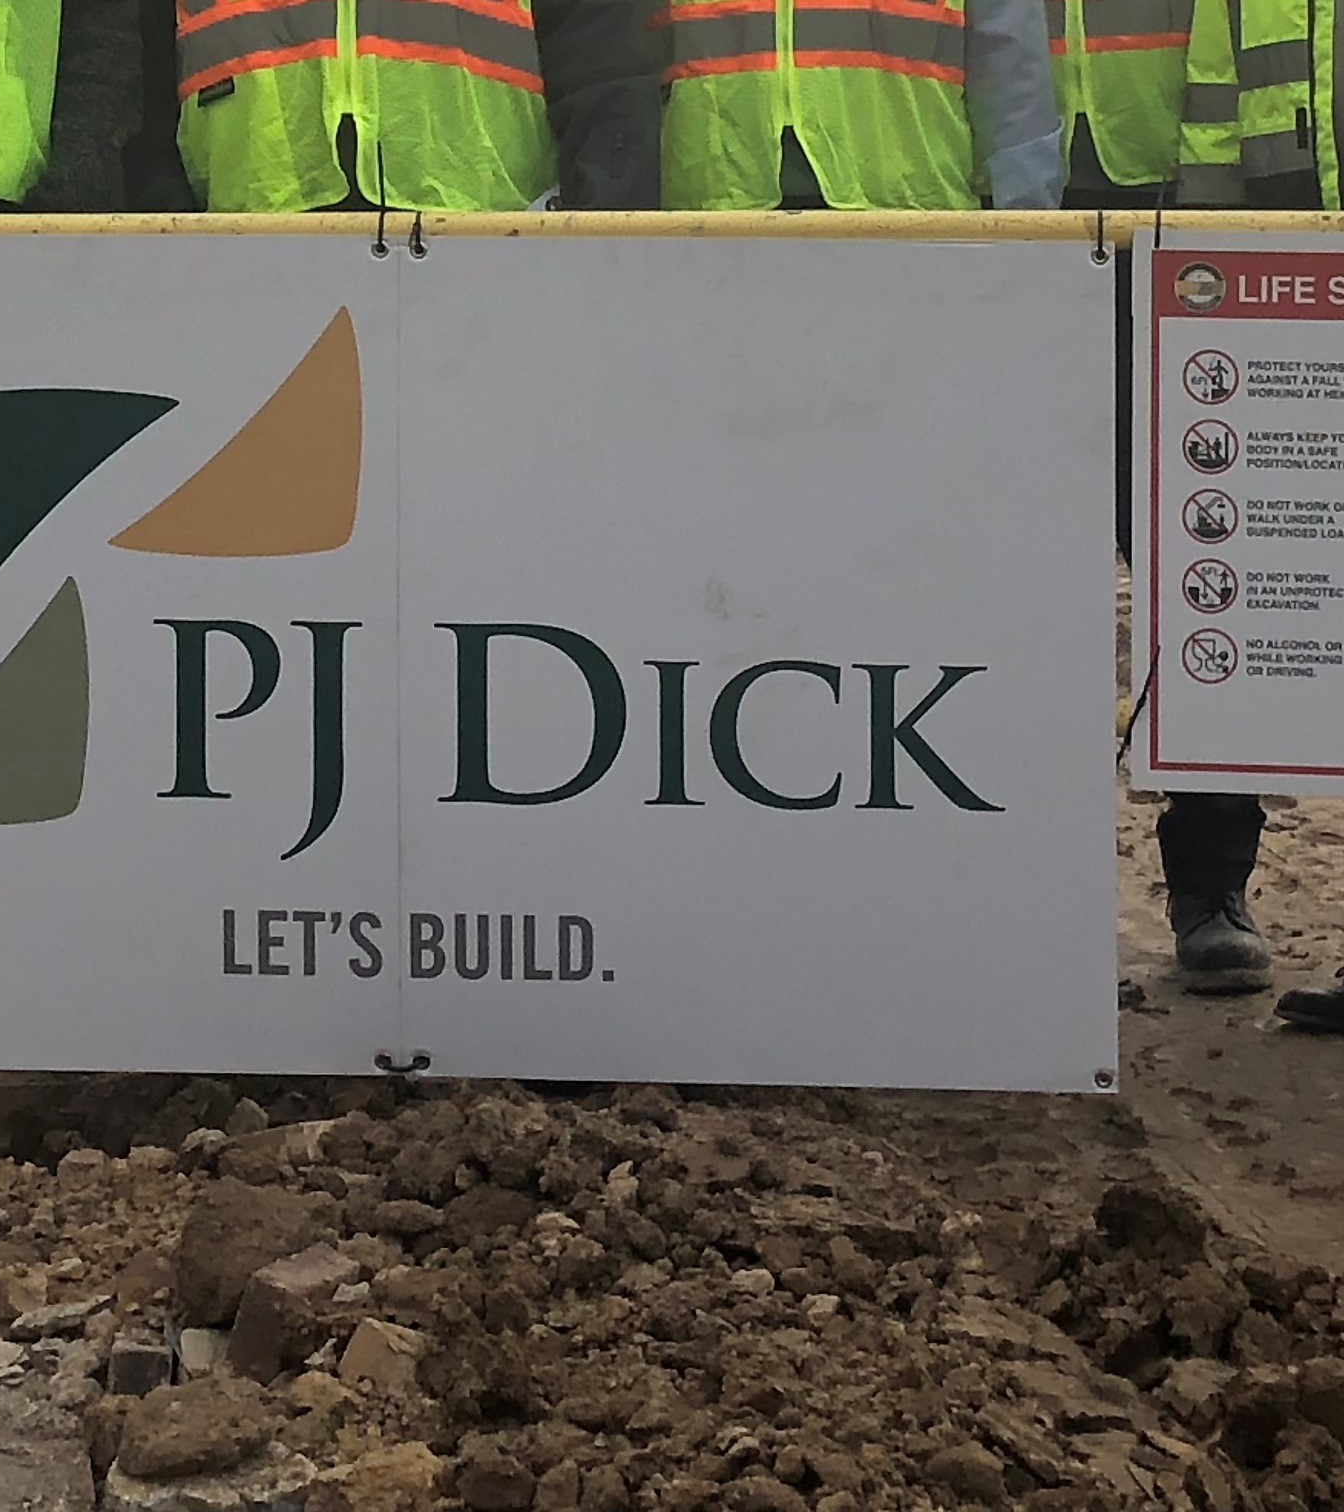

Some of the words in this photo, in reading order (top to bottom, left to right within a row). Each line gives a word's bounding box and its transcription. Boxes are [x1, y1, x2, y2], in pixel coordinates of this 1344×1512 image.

[1239, 276, 1316, 304] LIFE
[1248, 361, 1301, 372] PROTECT
[1248, 375, 1299, 385] AGAINST
[1301, 376, 1309, 385] A
[1312, 376, 1340, 386] FALL
[1248, 389, 1303, 399] WORKING
[1307, 389, 1320, 399] AT
[1247, 432, 1293, 442] ALWAYS
[1298, 433, 1328, 442] KEEP
[1247, 445, 1278, 455] BODY
[1297, 446, 1305, 456] A
[1308, 447, 1338, 456] SAFE
[1247, 500, 1264, 510] DO
[1267, 501, 1291, 510] NOT
[1294, 502, 1330, 511] WORK
[1247, 514, 1280, 523] WALK
[1284, 515, 1324, 524] UNDER
[1327, 515, 1335, 524] A
[1247, 527, 1317, 538] SUSPENDED
[1247, 572, 1263, 582] DO
[1267, 573, 1290, 582] NOT
[1294, 574, 1330, 583] WORK
[1247, 639, 1264, 649] NO
[1267, 640, 1321, 650] ALCOHOL
[1247, 653, 1284, 663] WHILE
[1292, 654, 1342, 664] WORKING
[154, 618, 362, 861] PJ
[434, 622, 1006, 812] DICK
[222, 908, 383, 979] LET'S
[409, 912, 615, 982] BUILD.
